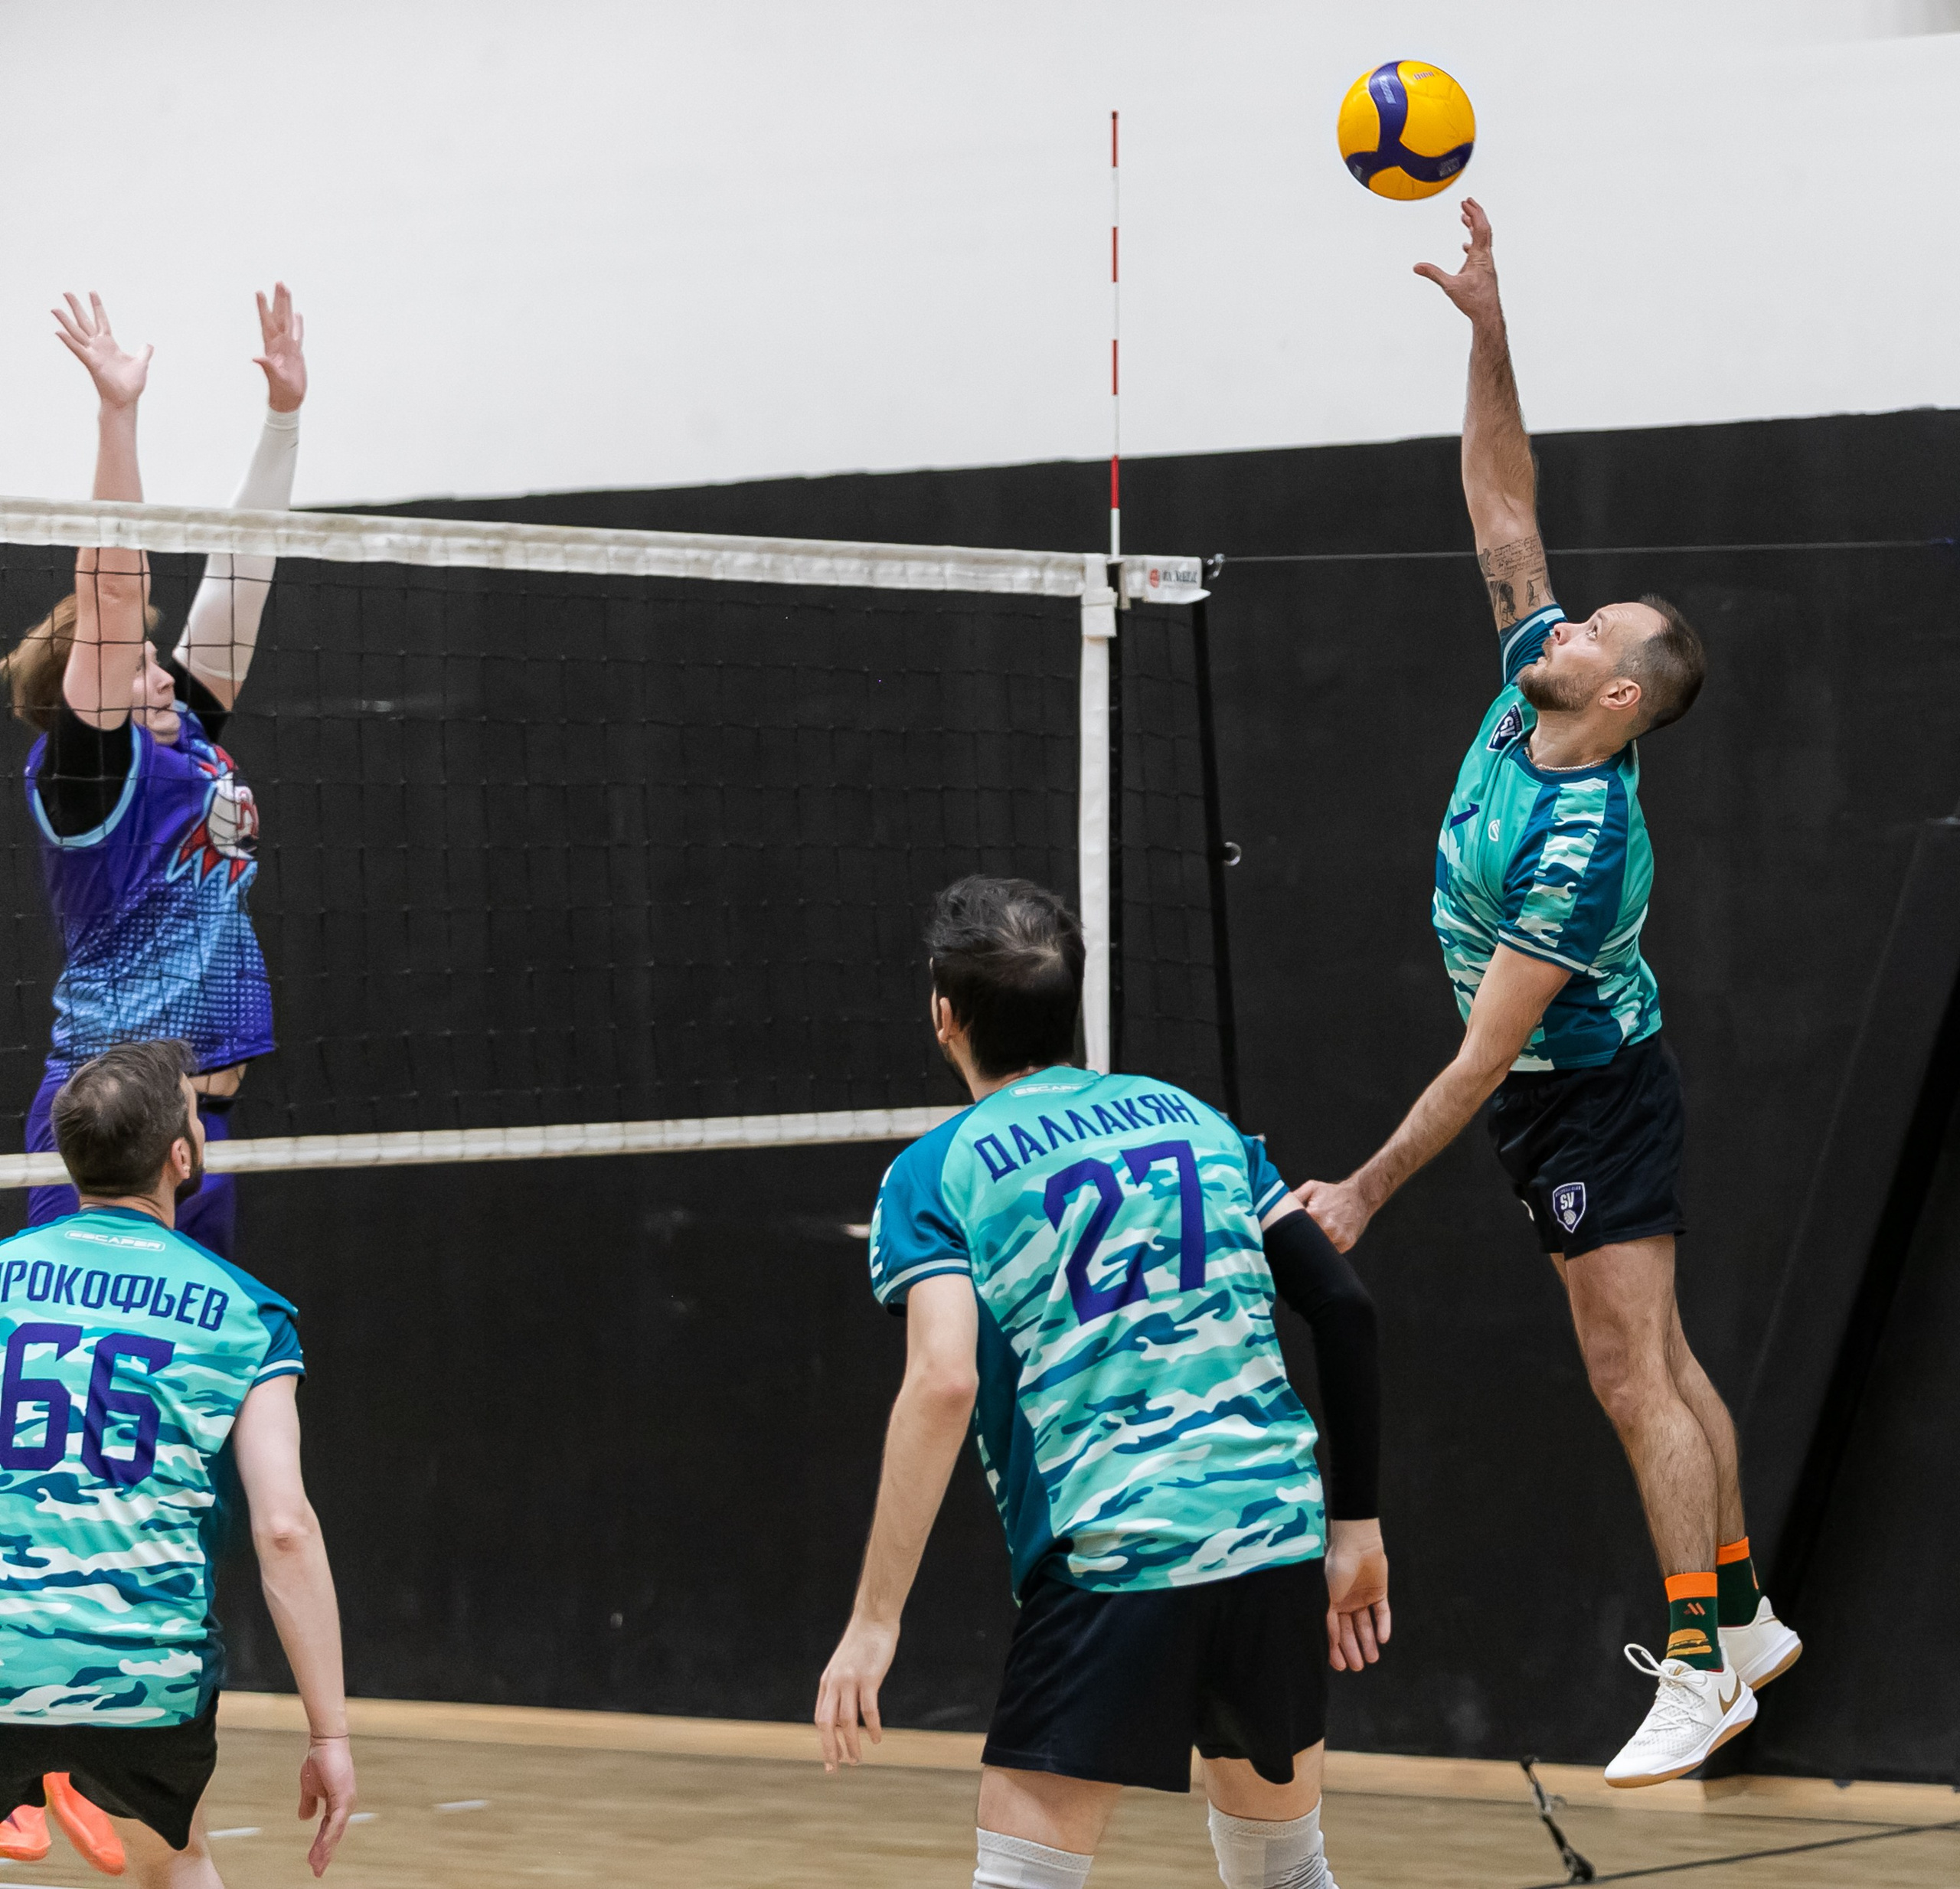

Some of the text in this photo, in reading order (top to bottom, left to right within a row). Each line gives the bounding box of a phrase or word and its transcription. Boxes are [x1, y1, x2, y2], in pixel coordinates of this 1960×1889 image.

[975, 1093, 1200, 1183] ДАЛЛАКЯН
[1044, 1139, 1206, 1326] 27
[1560, 1191, 1574, 1210] SV
[0, 1260, 229, 1332] РОКОФЬЕВ
[0, 1322, 176, 1487] 66
